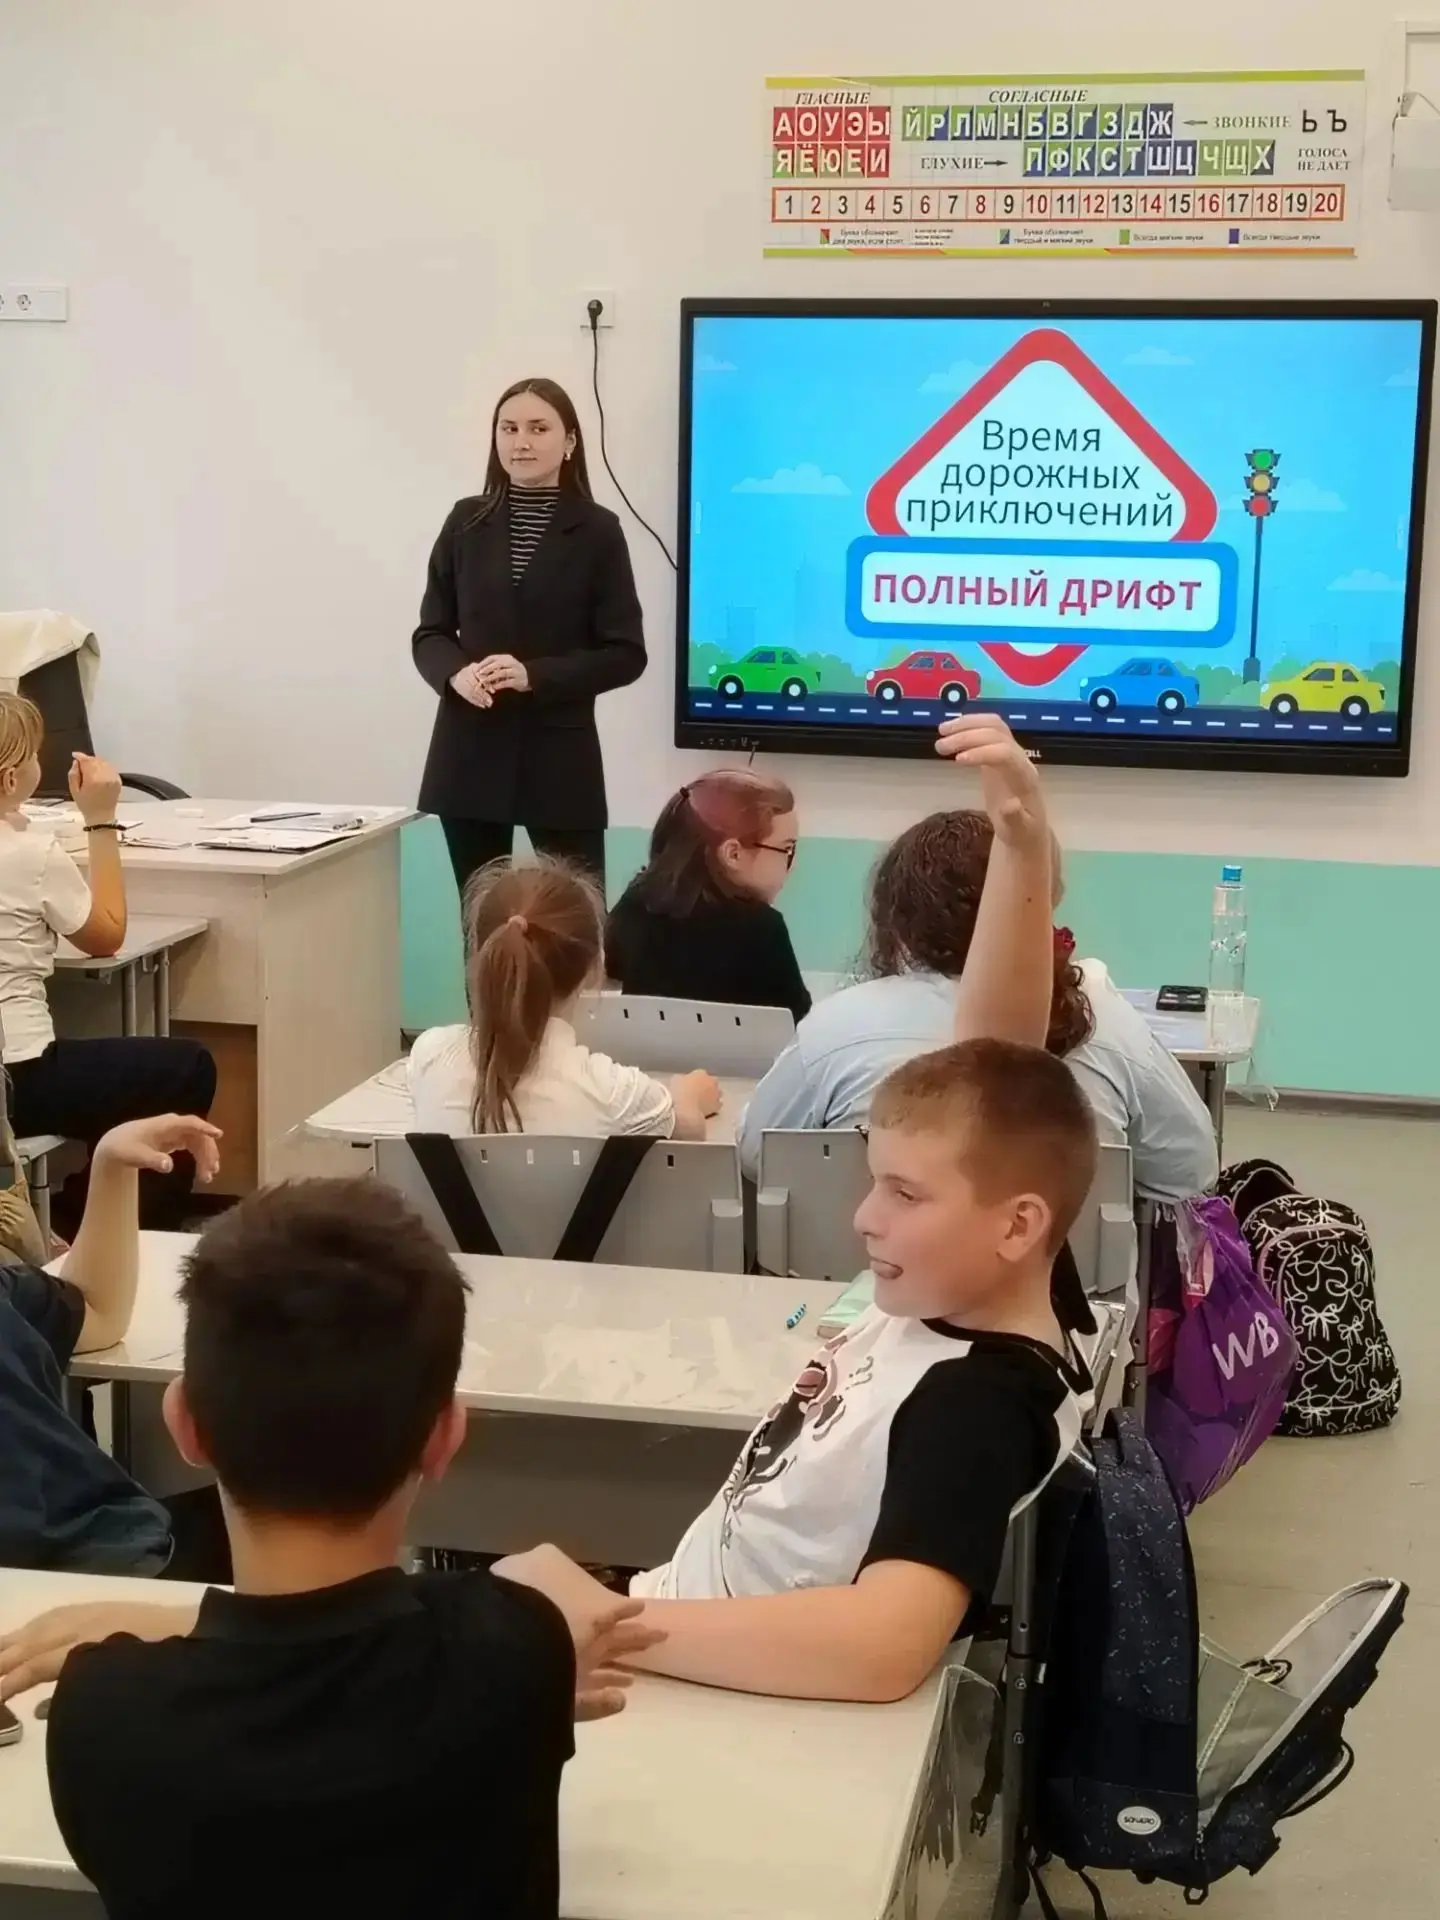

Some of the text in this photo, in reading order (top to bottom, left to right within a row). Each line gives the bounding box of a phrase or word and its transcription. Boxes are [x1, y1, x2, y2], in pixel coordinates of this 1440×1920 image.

[795, 92, 870, 105] ГЛАСНЫЕ
[989, 89, 1088, 104] СОГЛАСНЫЕ
[1213, 115, 1291, 129] ЗВОНКИЕ
[1298, 148, 1347, 159] ГОЛОСА
[921, 157, 983, 170] ГЛУХИЕ
[1298, 160, 1314, 171] НЕ
[785, 192, 1338, 214] 1 2 3 4 5 6 7 8 9 10 11 12 13 14 15 16 17 18 19 20
[982, 419, 1101, 459] Время
[940, 462, 1140, 495] дорожных
[906, 493, 1173, 531] приключений
[873, 569, 1202, 617] ПОЛНЫЙ ДРИФТ
[1212, 1311, 1280, 1381] WB
